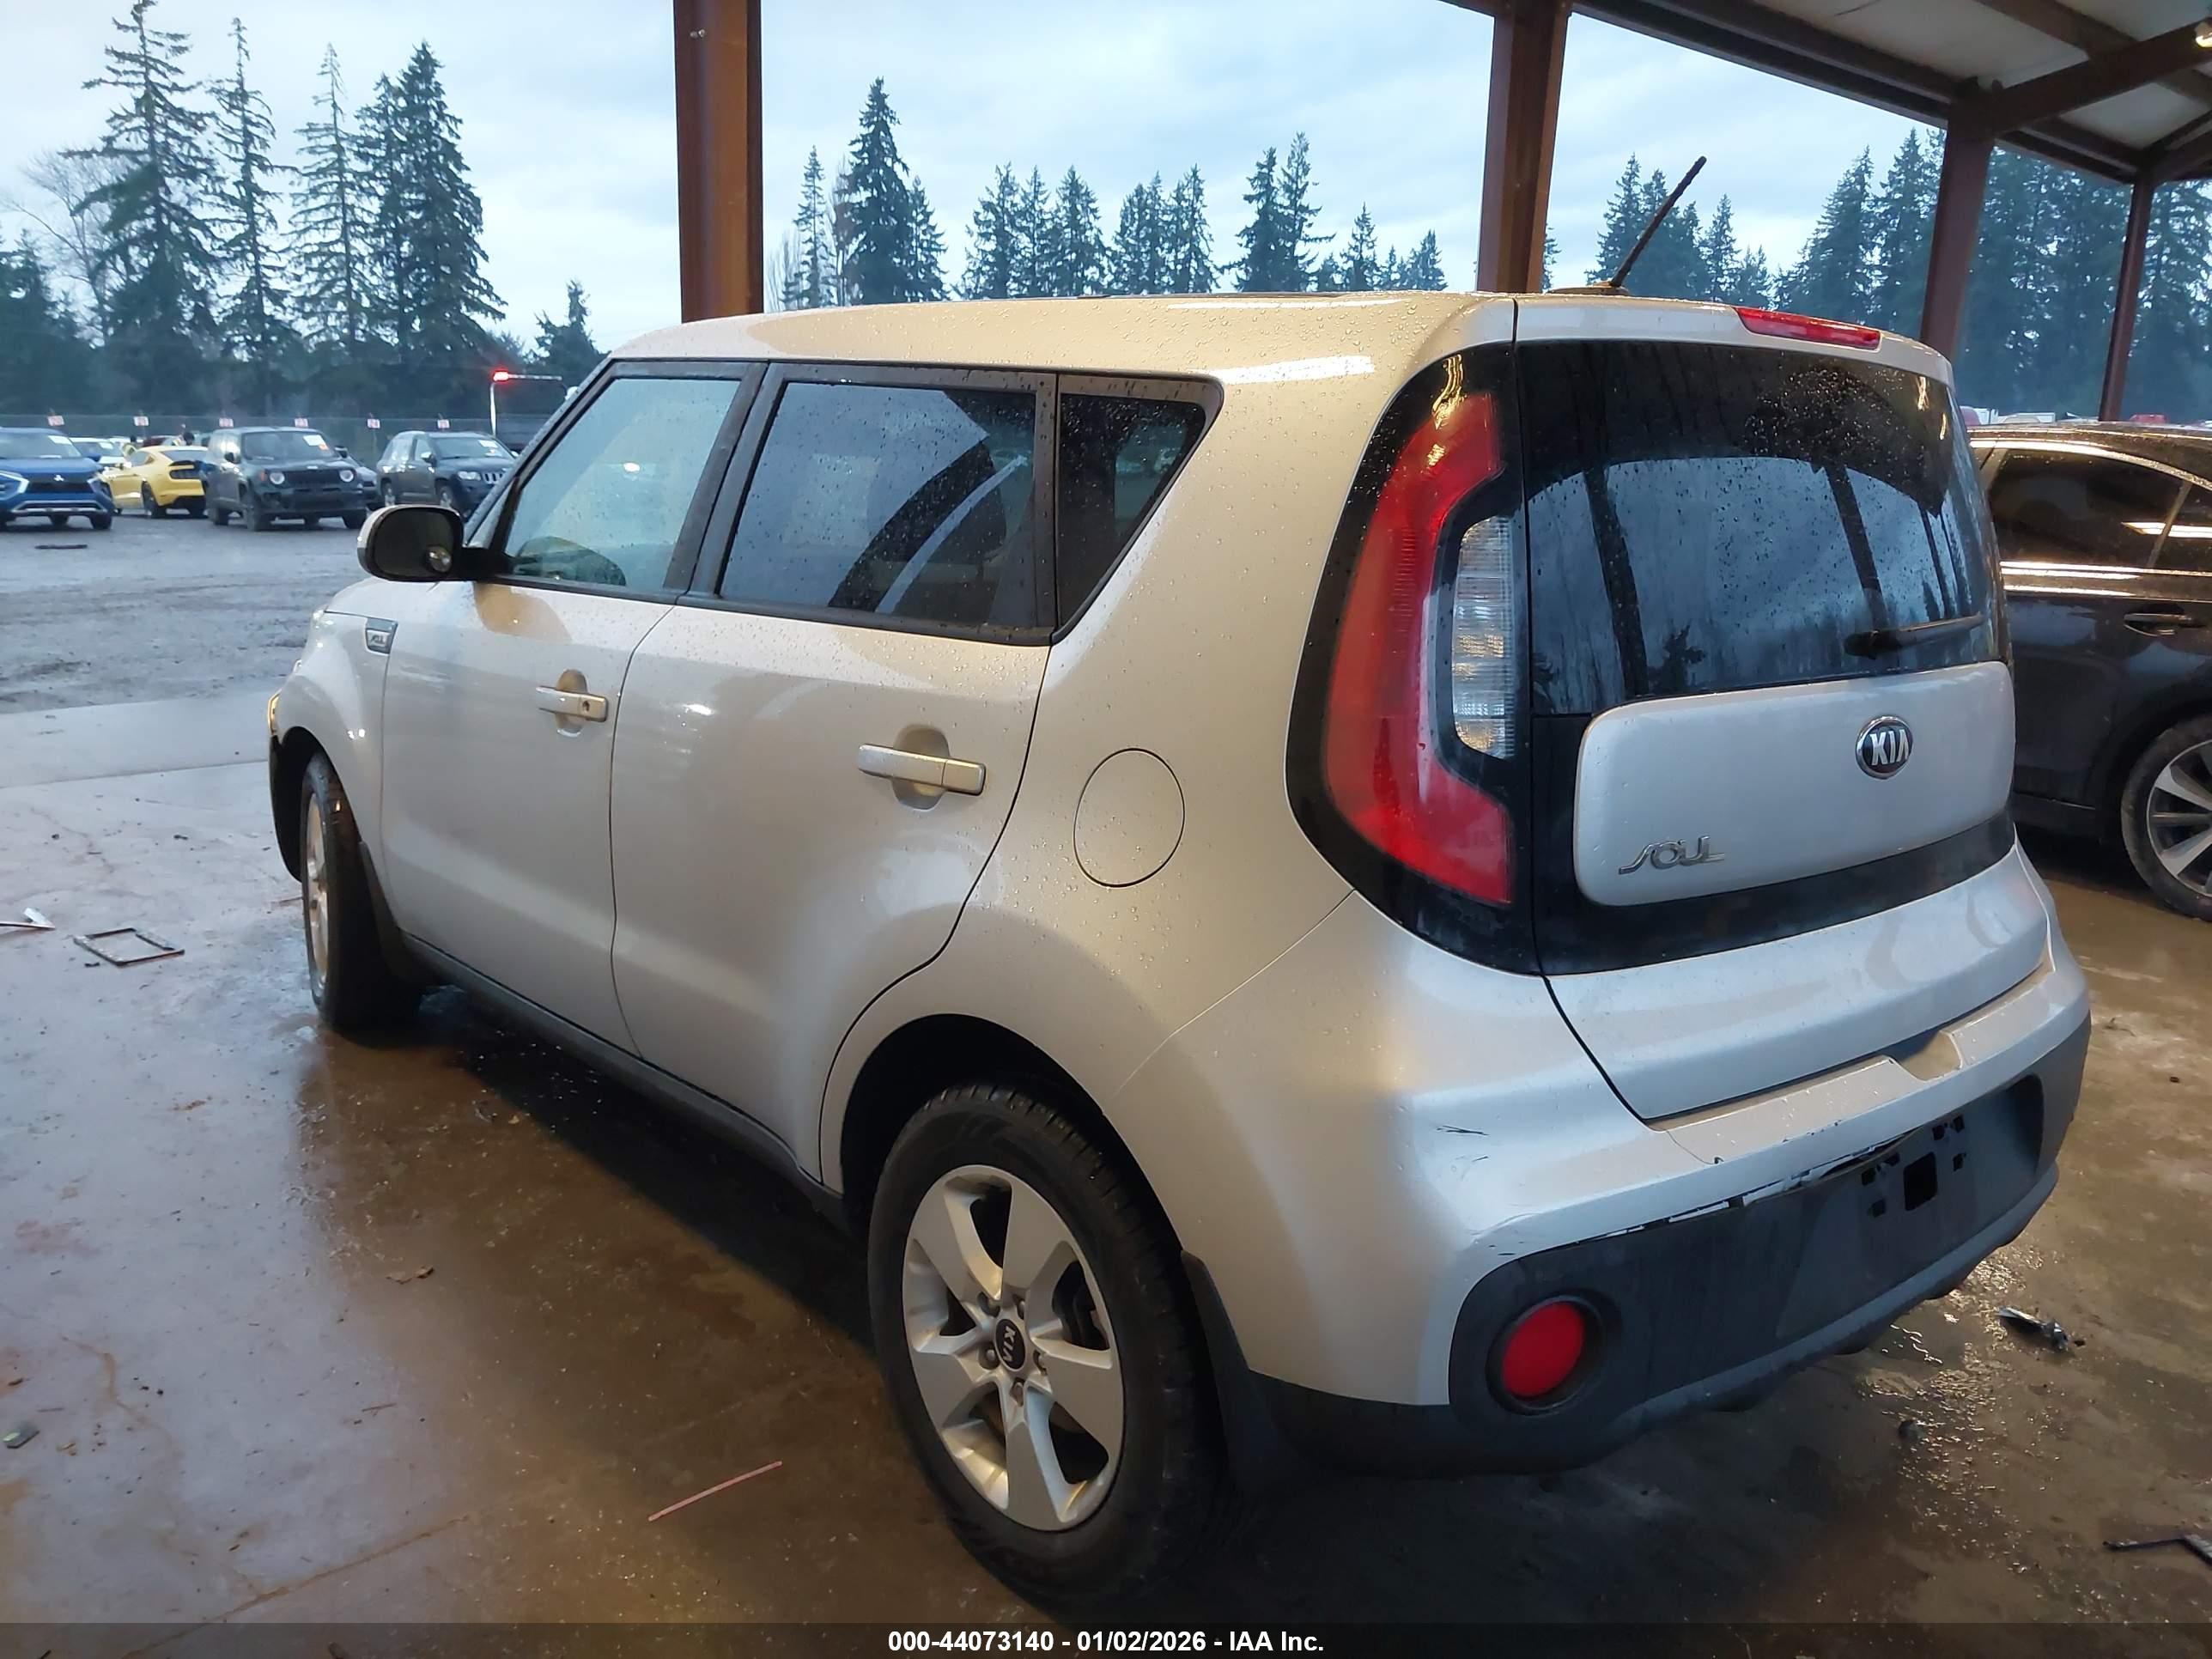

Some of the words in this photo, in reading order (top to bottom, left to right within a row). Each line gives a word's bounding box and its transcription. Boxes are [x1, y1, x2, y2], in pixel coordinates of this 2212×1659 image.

[1869, 728, 1910, 766] KIA
[1618, 835, 1725, 875] SOUL
[1002, 1325, 1017, 1362] KIA
